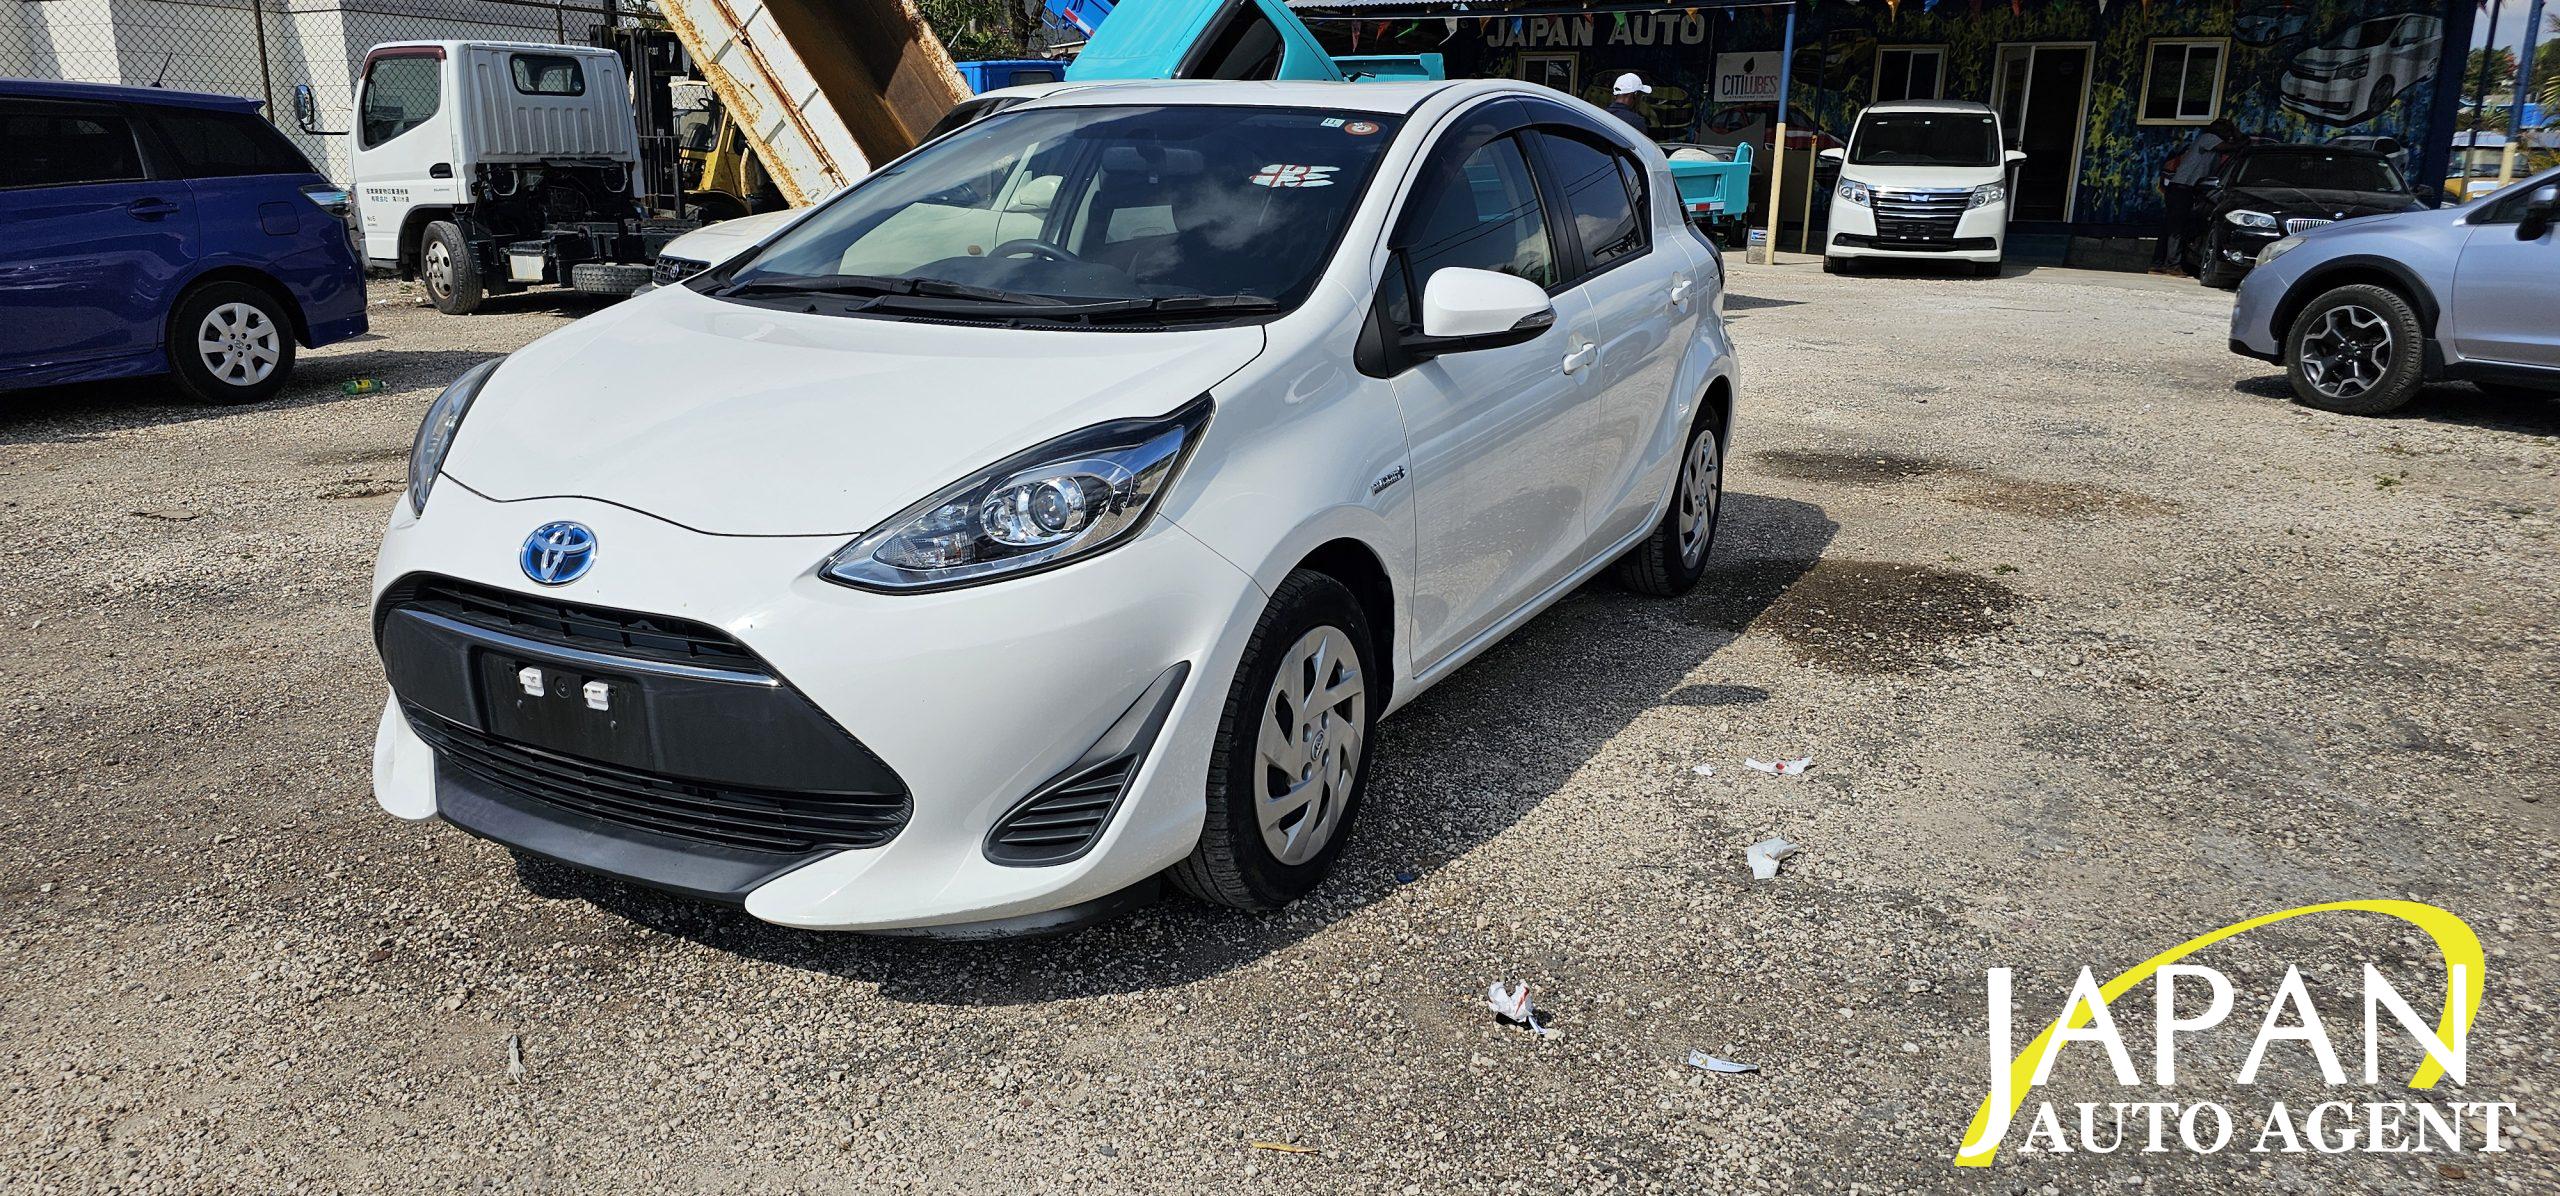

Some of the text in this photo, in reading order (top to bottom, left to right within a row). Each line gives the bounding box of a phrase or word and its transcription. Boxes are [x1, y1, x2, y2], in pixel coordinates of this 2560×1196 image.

[1486, 13, 1706, 48] JAPAN AUTO
[1722, 74, 1777, 96] CITILUBES
